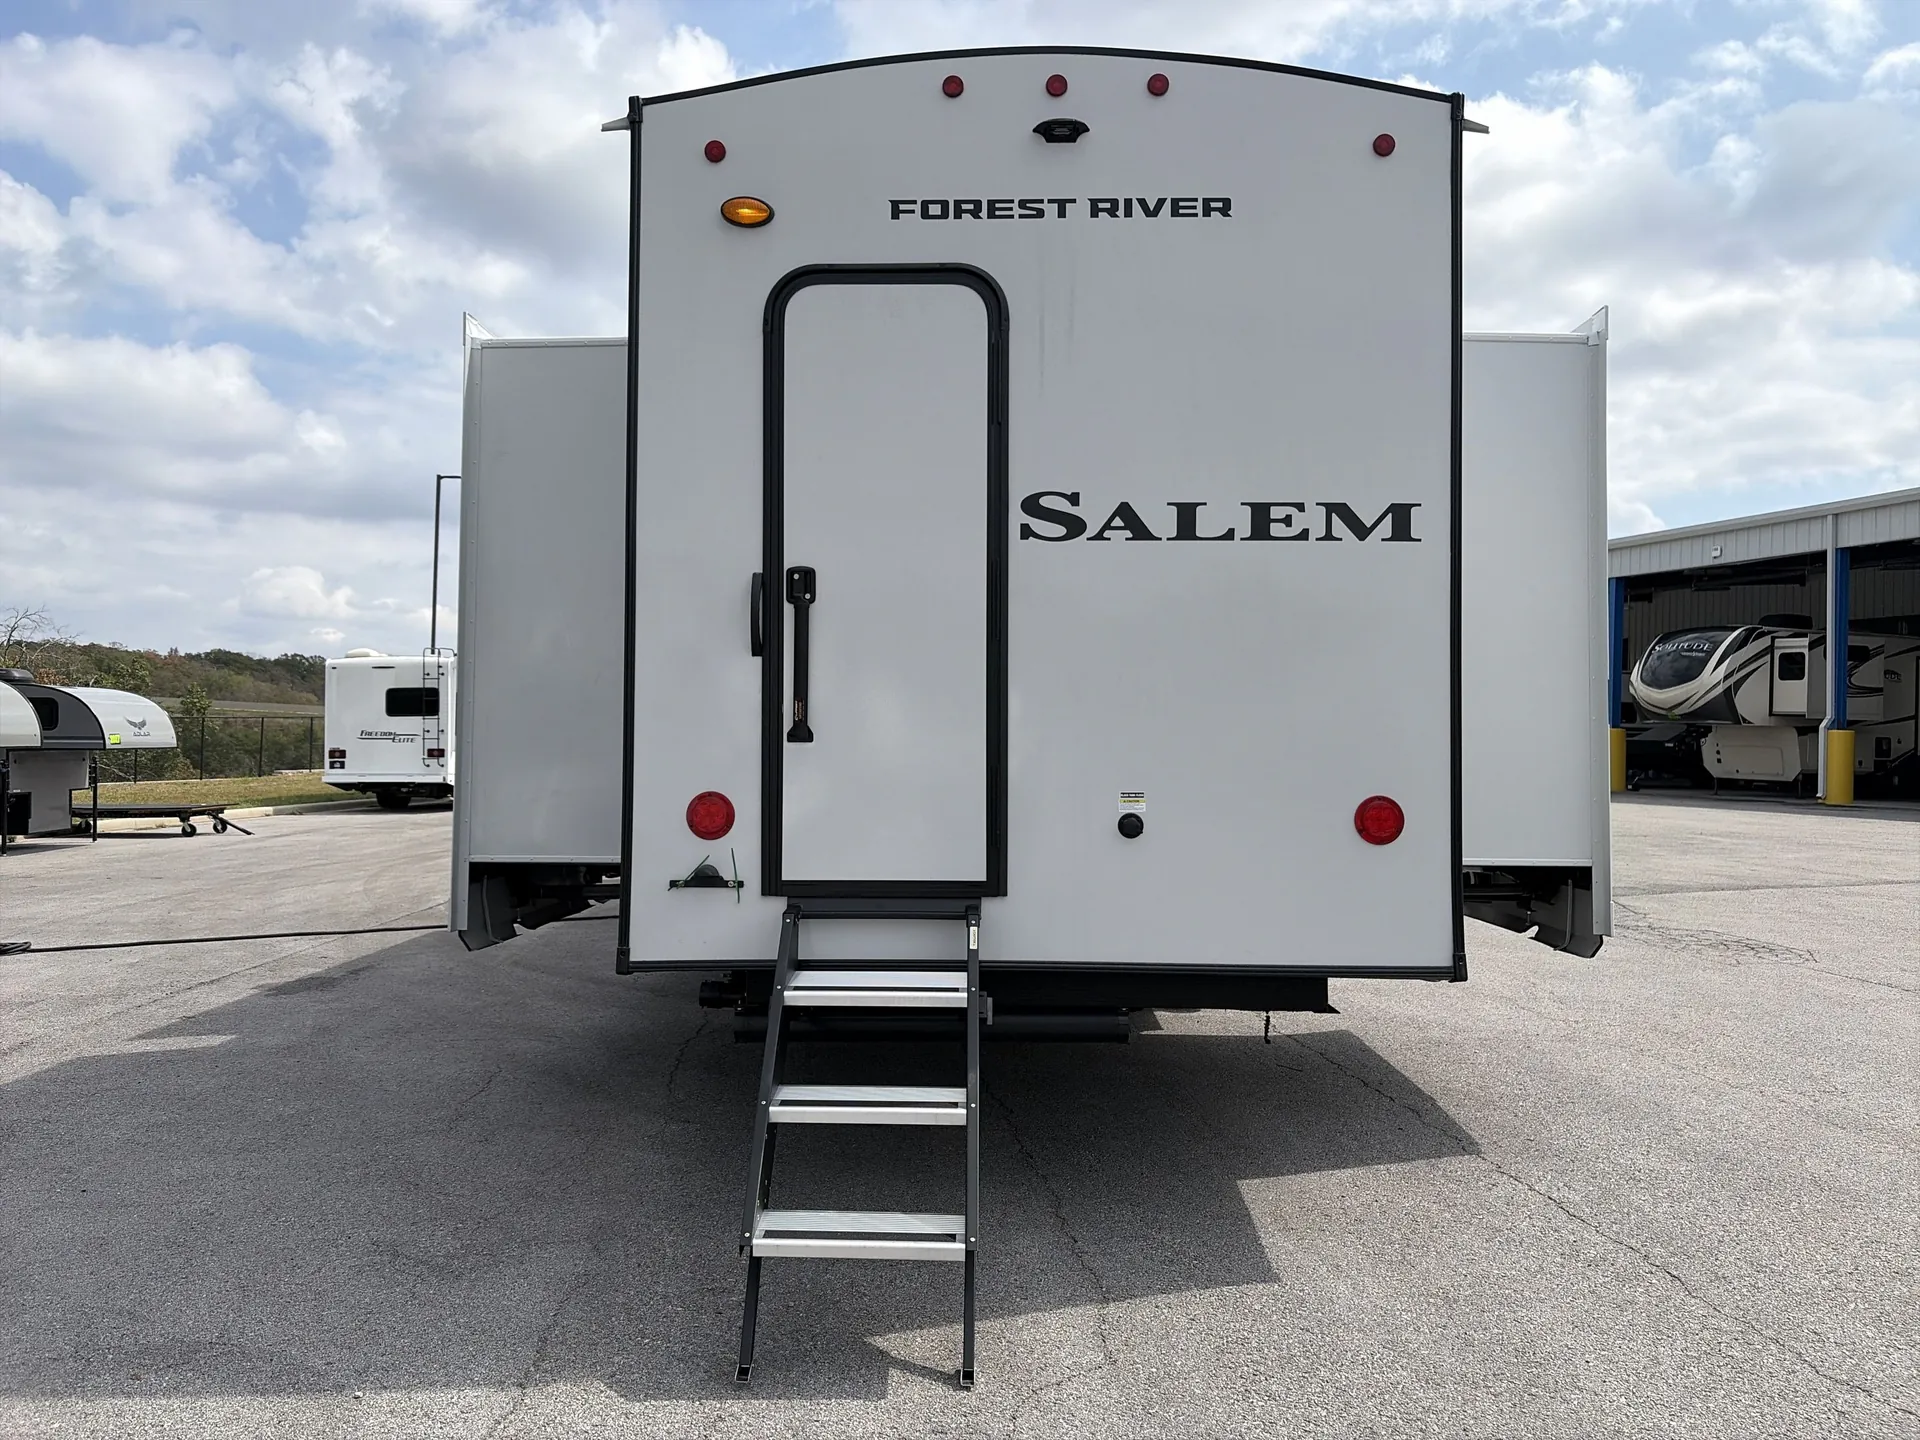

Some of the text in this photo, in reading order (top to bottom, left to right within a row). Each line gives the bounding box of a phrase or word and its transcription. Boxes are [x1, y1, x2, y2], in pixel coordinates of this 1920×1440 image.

[888, 197, 1233, 220] FOREST RIVER
[1019, 490, 1422, 543] SALEM
